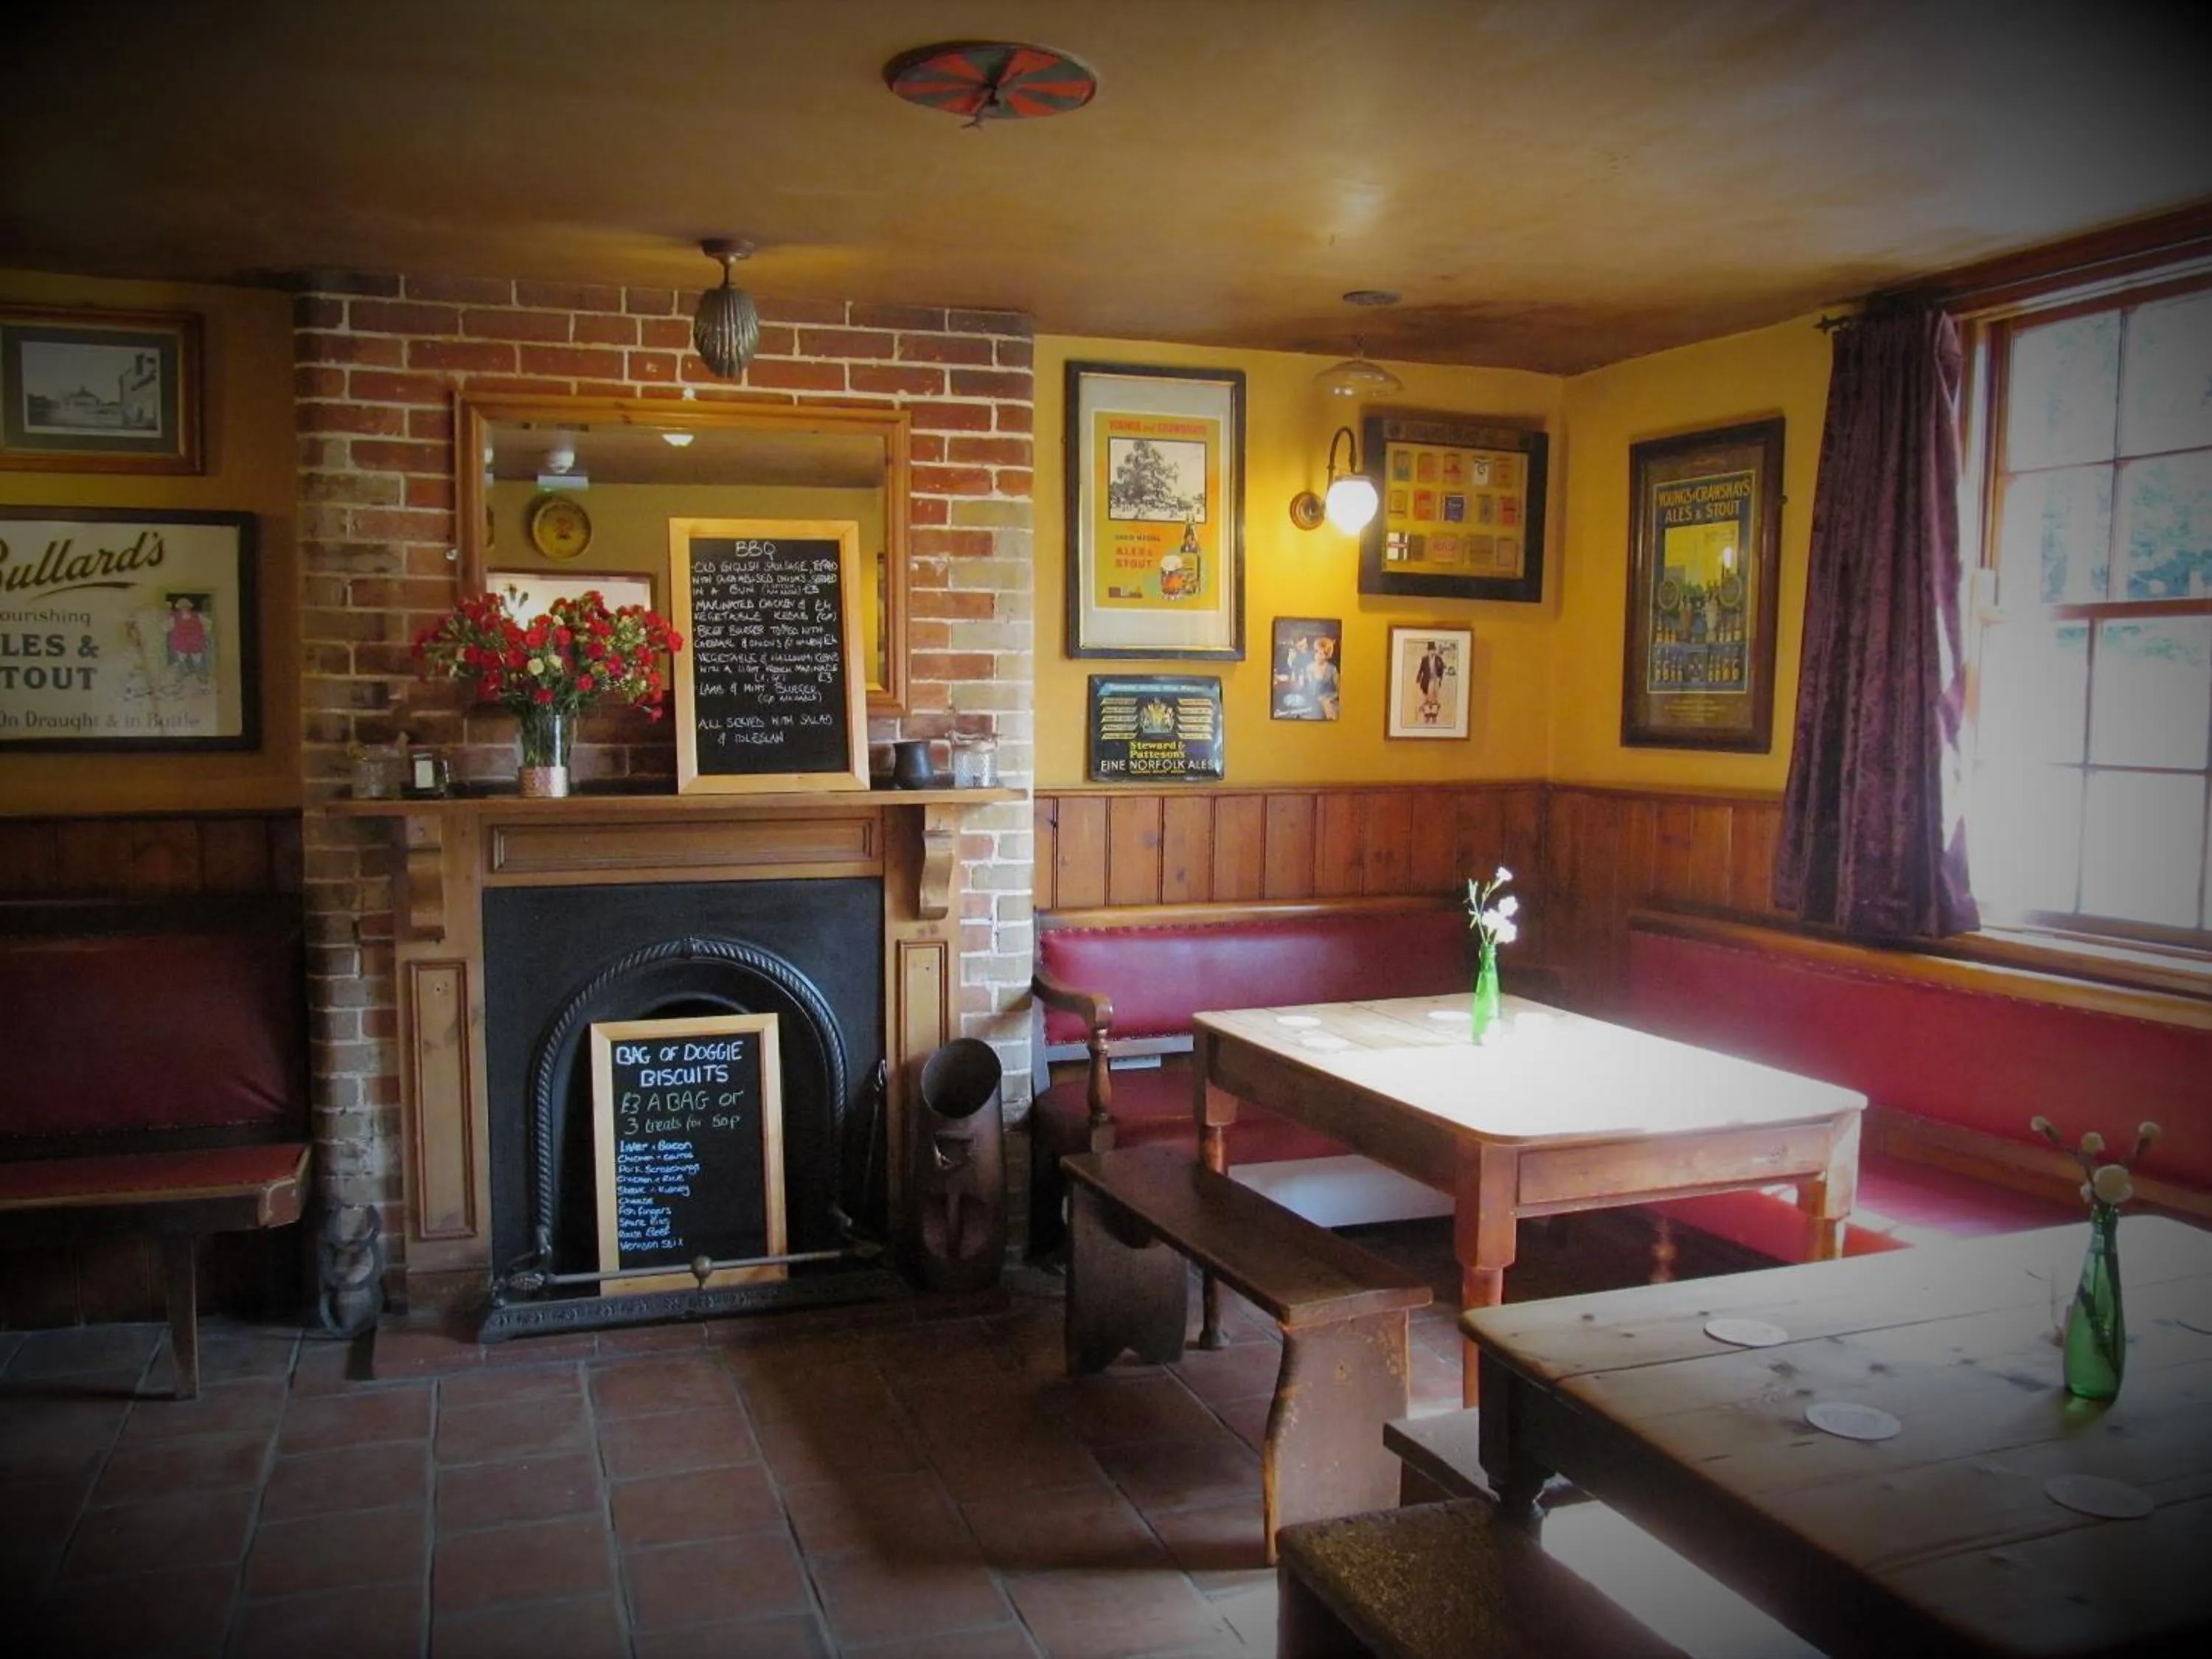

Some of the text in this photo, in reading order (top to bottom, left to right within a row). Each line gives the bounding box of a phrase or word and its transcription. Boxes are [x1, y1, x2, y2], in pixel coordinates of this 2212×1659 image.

[1665, 505, 1693, 525] ALES
[1706, 499, 1741, 519] STOUT
[736, 540, 776, 560] BBQ
[693, 585, 704, 595] IN
[695, 611, 762, 622] VEGETABLE
[728, 625, 765, 636] BURGER
[801, 625, 824, 635] WITH
[77, 636, 100, 658] &
[698, 653, 757, 663] VEGETABLE
[700, 683, 725, 695] LAMB
[743, 683, 765, 693] MINT
[25, 711, 99, 732] Draught
[698, 713, 833, 729] ALL SERVED WITH SALAD
[1130, 740, 1177, 751] Steward
[1101, 759, 1214, 773] FINE NORFOLK ALES
[616, 1040, 744, 1065] BAG OF DOGGIE
[640, 1064, 730, 1088] BISCUITS
[621, 1091, 641, 1114] £3
[647, 1092, 661, 1111] A
[666, 1091, 710, 1112] BAG
[624, 1116, 639, 1135] 3
[657, 1139, 693, 1152] Bacon
